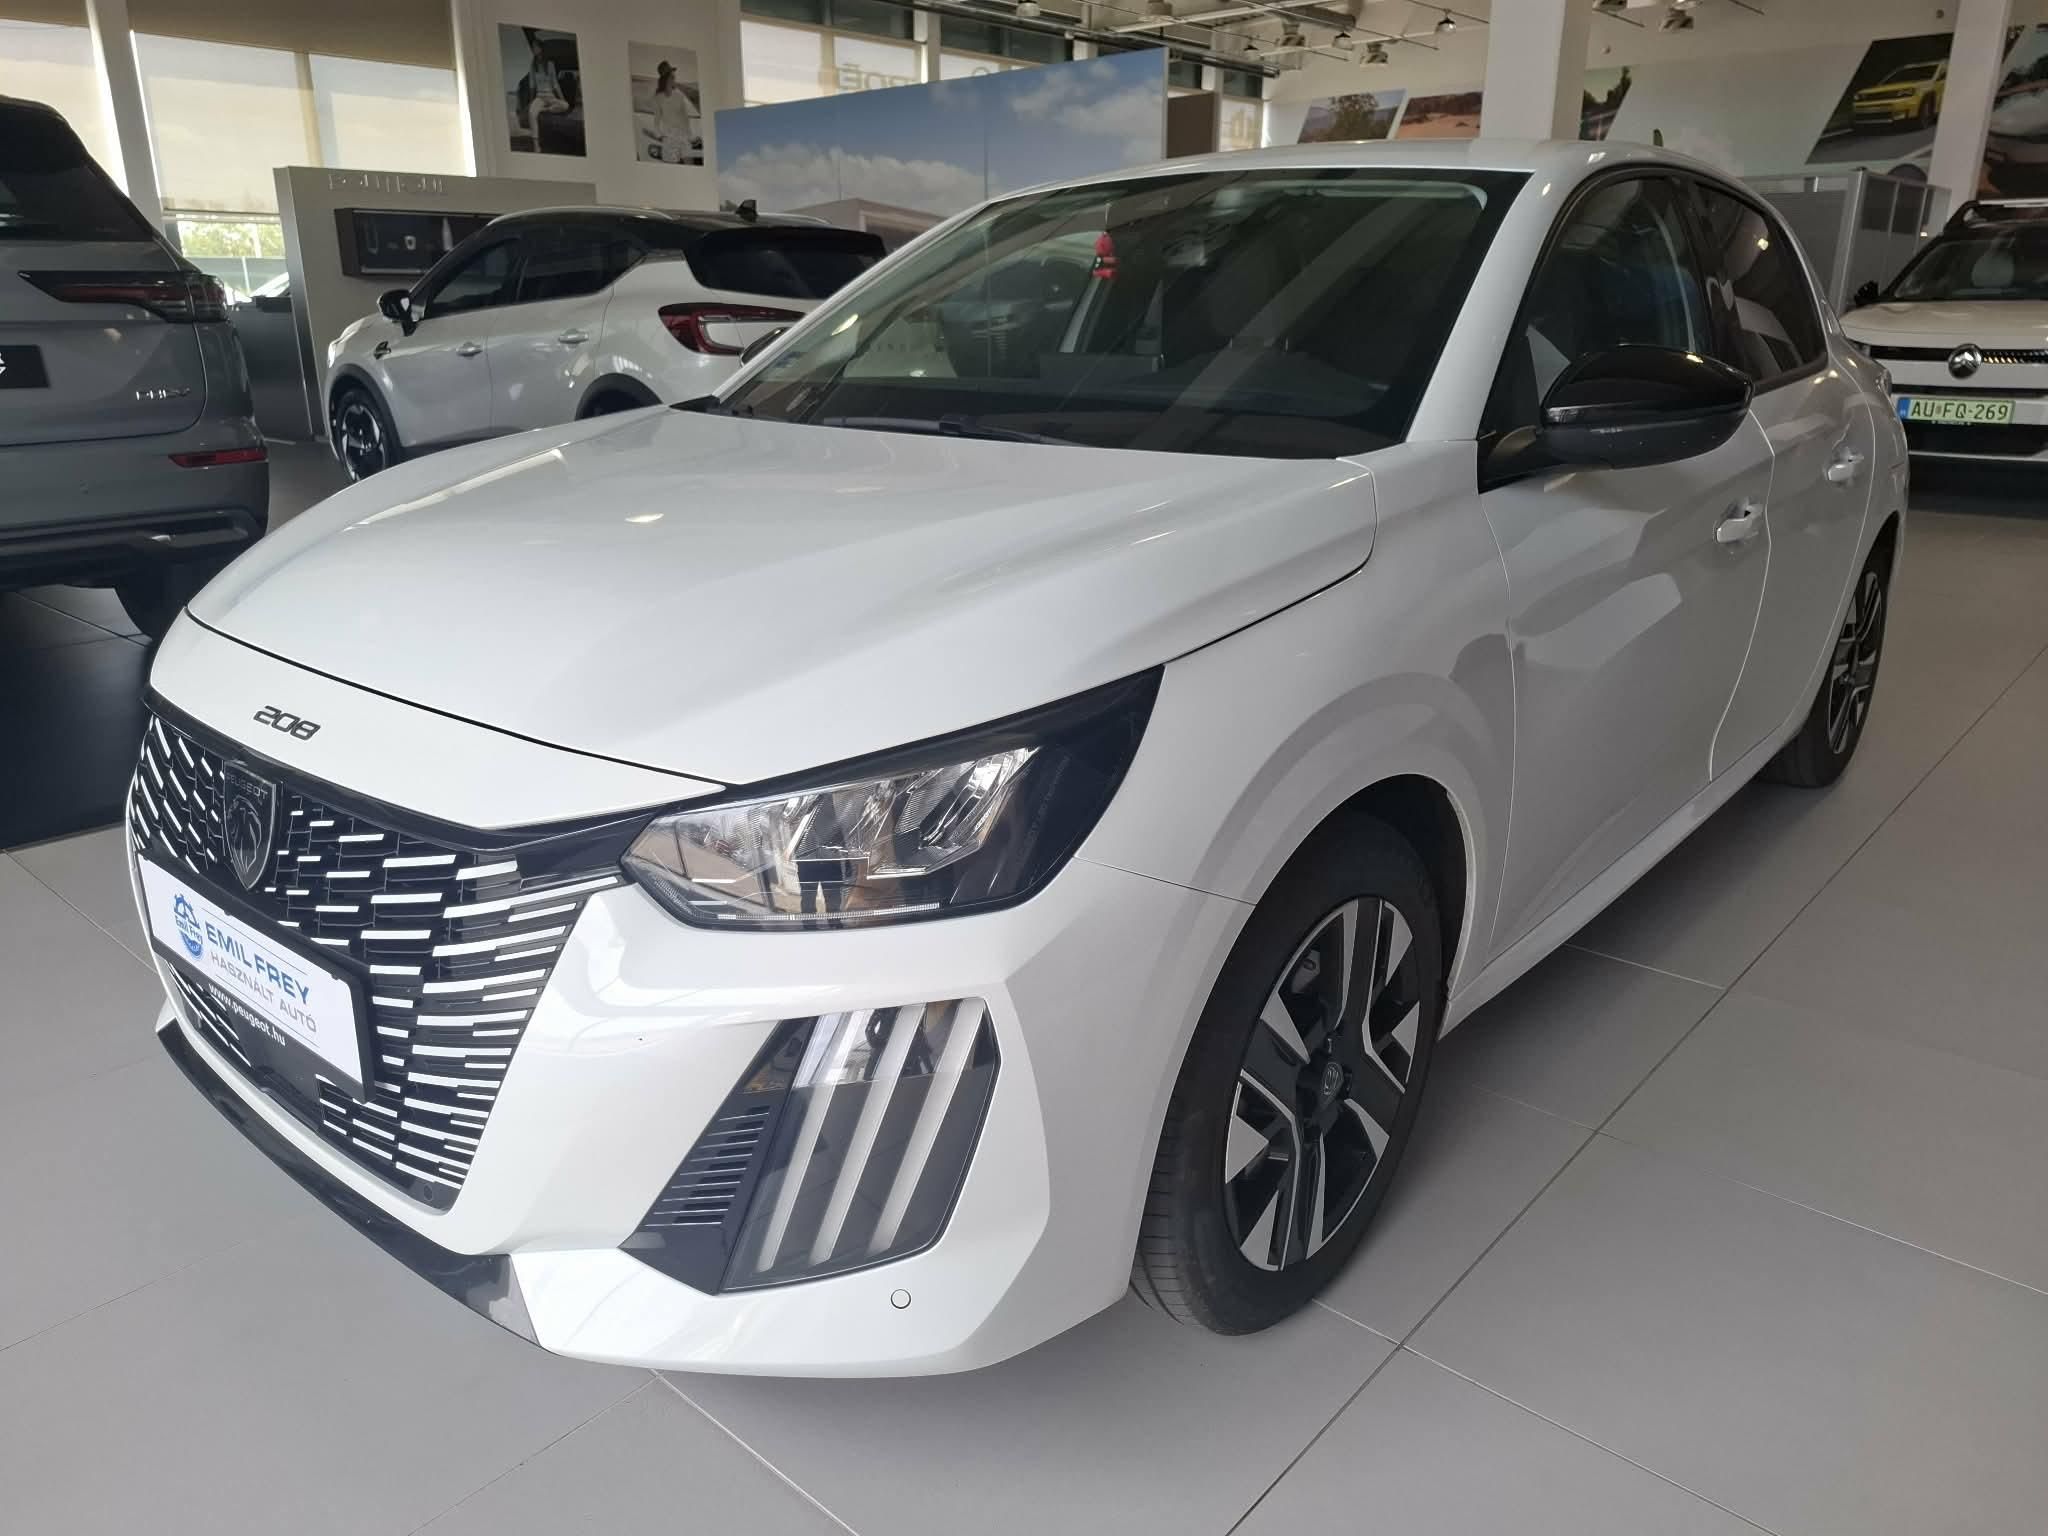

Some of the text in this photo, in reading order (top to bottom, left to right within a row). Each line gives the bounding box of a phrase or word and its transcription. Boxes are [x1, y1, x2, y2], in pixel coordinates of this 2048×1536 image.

[1911, 402, 1935, 417] AU
[1942, 402, 2009, 420] FQ-269
[253, 705, 321, 740] 208
[226, 773, 268, 800] PEUGEOT
[205, 920, 309, 1005] EMIL FREY
[208, 983, 286, 1047] www.peugeot.hu
[210, 951, 317, 1033] HASZNÁLT AUTÓ
